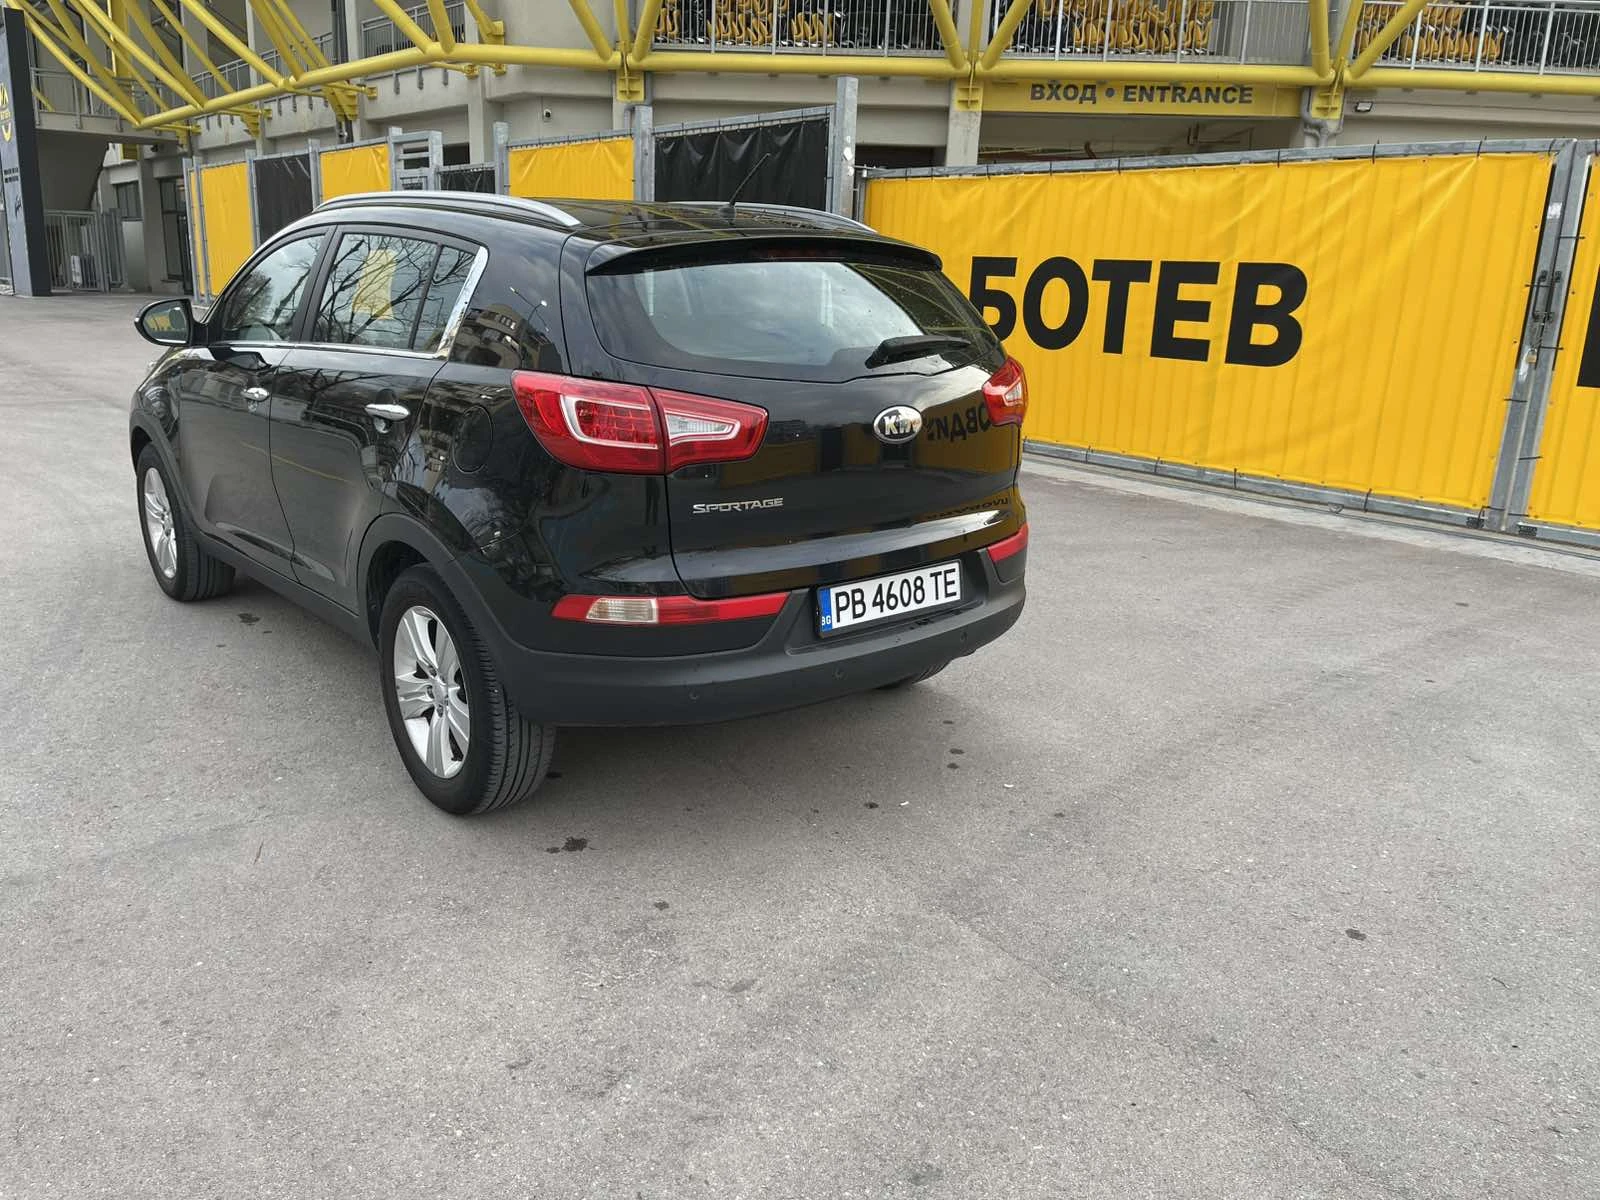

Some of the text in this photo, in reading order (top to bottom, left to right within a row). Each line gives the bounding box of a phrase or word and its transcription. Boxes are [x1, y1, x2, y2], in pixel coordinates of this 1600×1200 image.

[1030, 84, 1253, 104] ВХОД ENTRANCE
[969, 256, 1308, 367] БОТЕВ
[692, 497, 784, 514] SPORTAGE
[835, 568, 957, 623] PB 4608 TE
